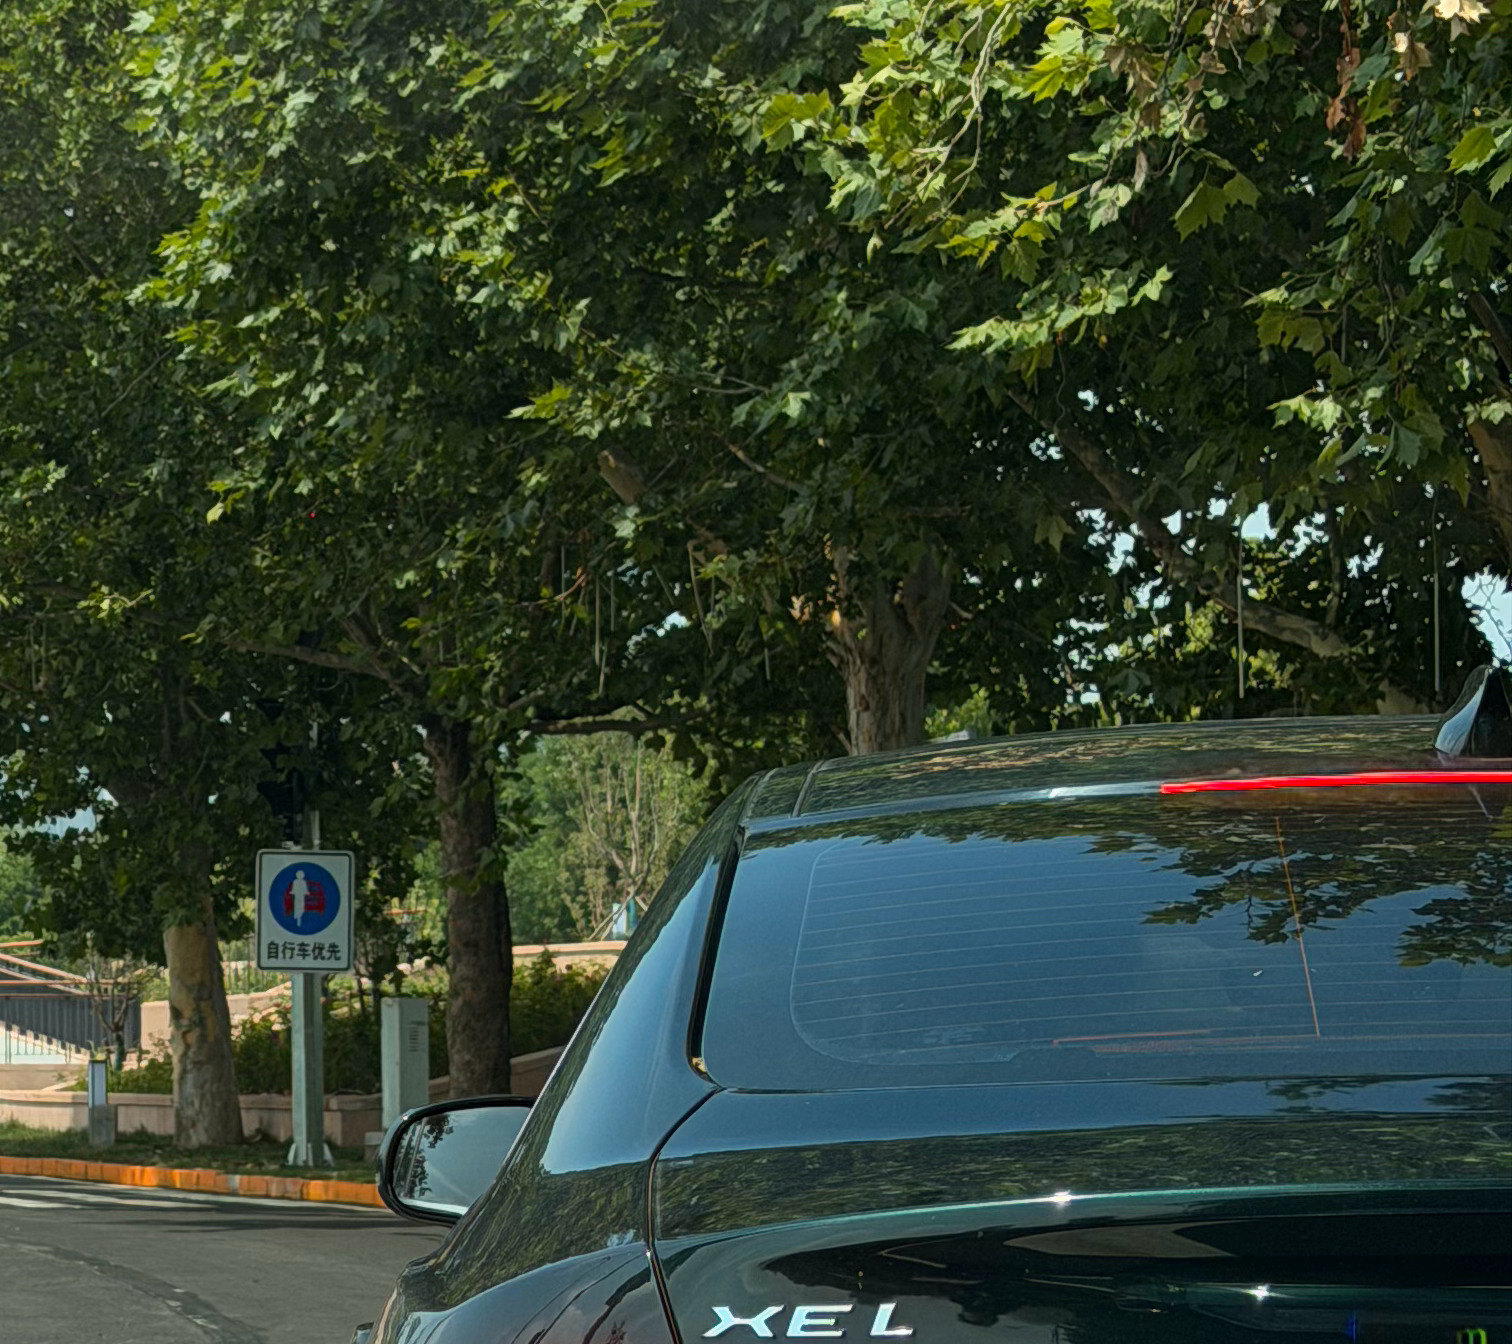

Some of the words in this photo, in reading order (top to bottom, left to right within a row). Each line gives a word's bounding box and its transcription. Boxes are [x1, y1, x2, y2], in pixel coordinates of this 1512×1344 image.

[267, 941, 341, 961] 自行车优先
[702, 1303, 915, 1338] XEL
